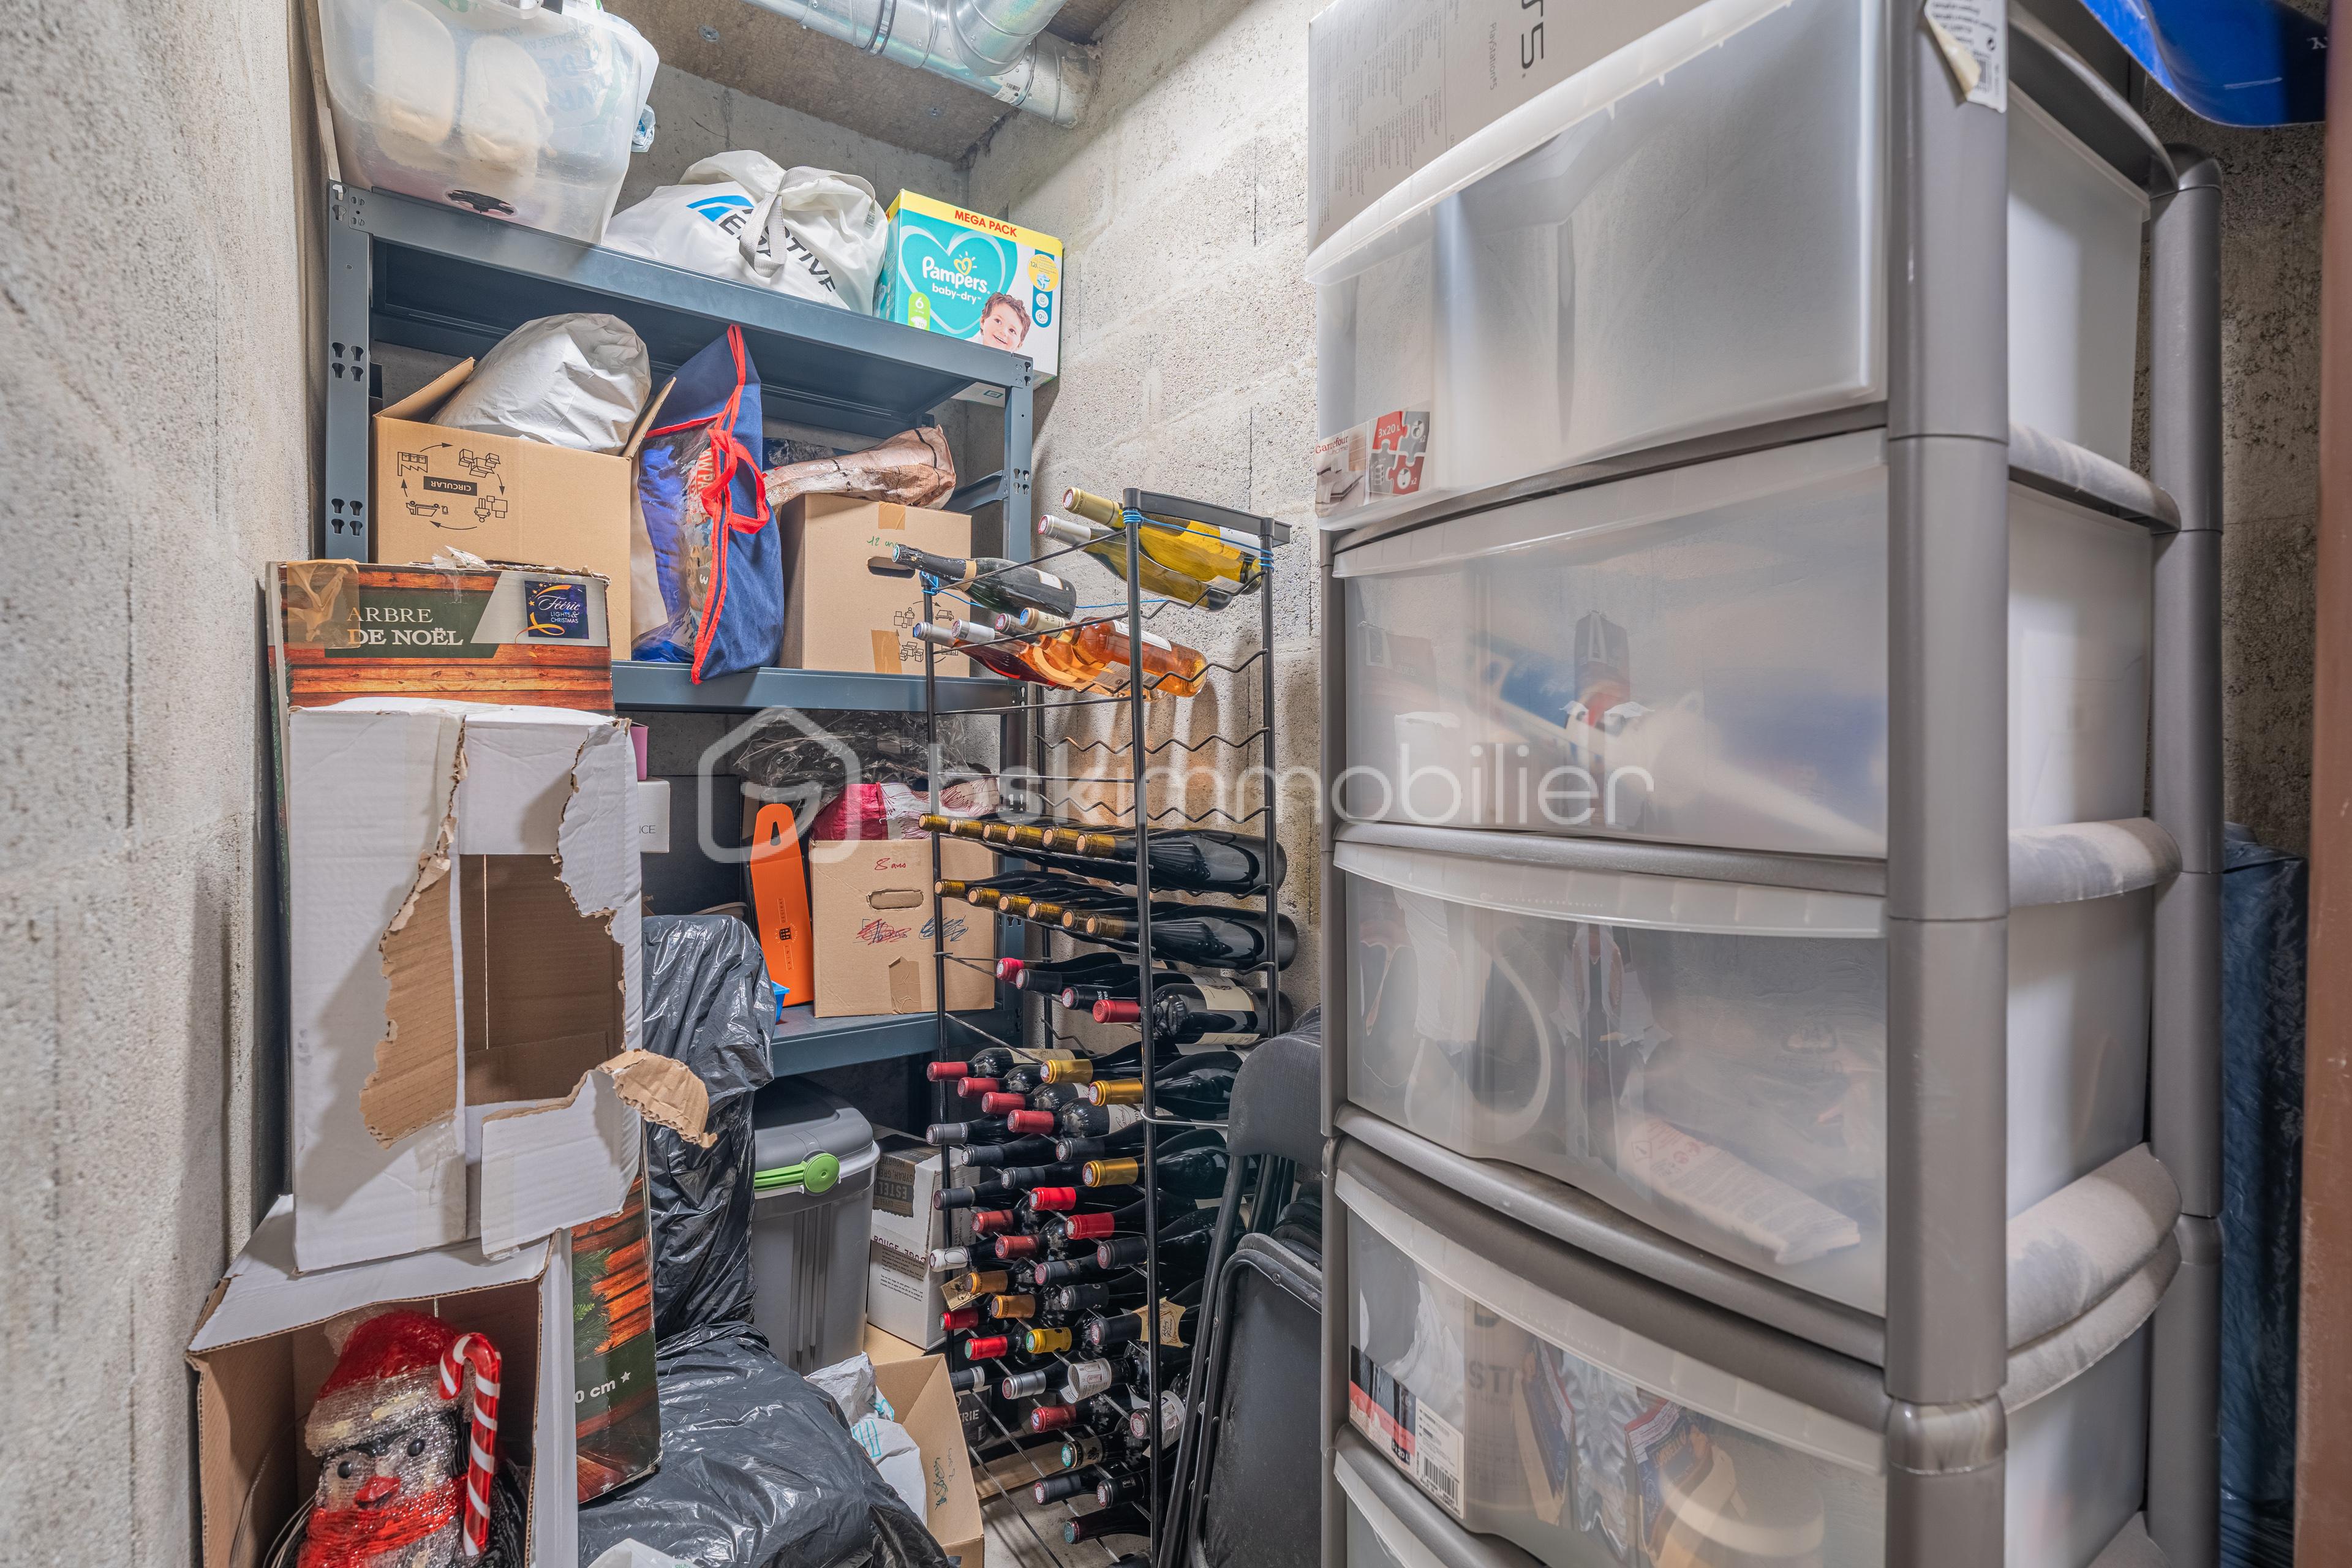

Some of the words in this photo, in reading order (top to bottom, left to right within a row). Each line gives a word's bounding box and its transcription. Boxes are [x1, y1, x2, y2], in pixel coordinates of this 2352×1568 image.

[954, 209, 986, 228] MEGA
[989, 221, 1017, 238] PACK
[922, 255, 988, 294] Pampers
[915, 296, 924, 309] 6
[1378, 424, 1396, 439] 3x20
[1315, 435, 1349, 454] Carrefour
[430, 480, 472, 492] CIRCULAR
[1411, 477, 1417, 486] x2
[867, 536, 880, 547] 12
[699, 574, 708, 585] 3
[347, 607, 434, 624] ARBRE
[347, 628, 387, 646] DE
[391, 627, 464, 646] NOËL
[875, 858, 889, 871] 8
[589, 1379, 616, 1398] cm
